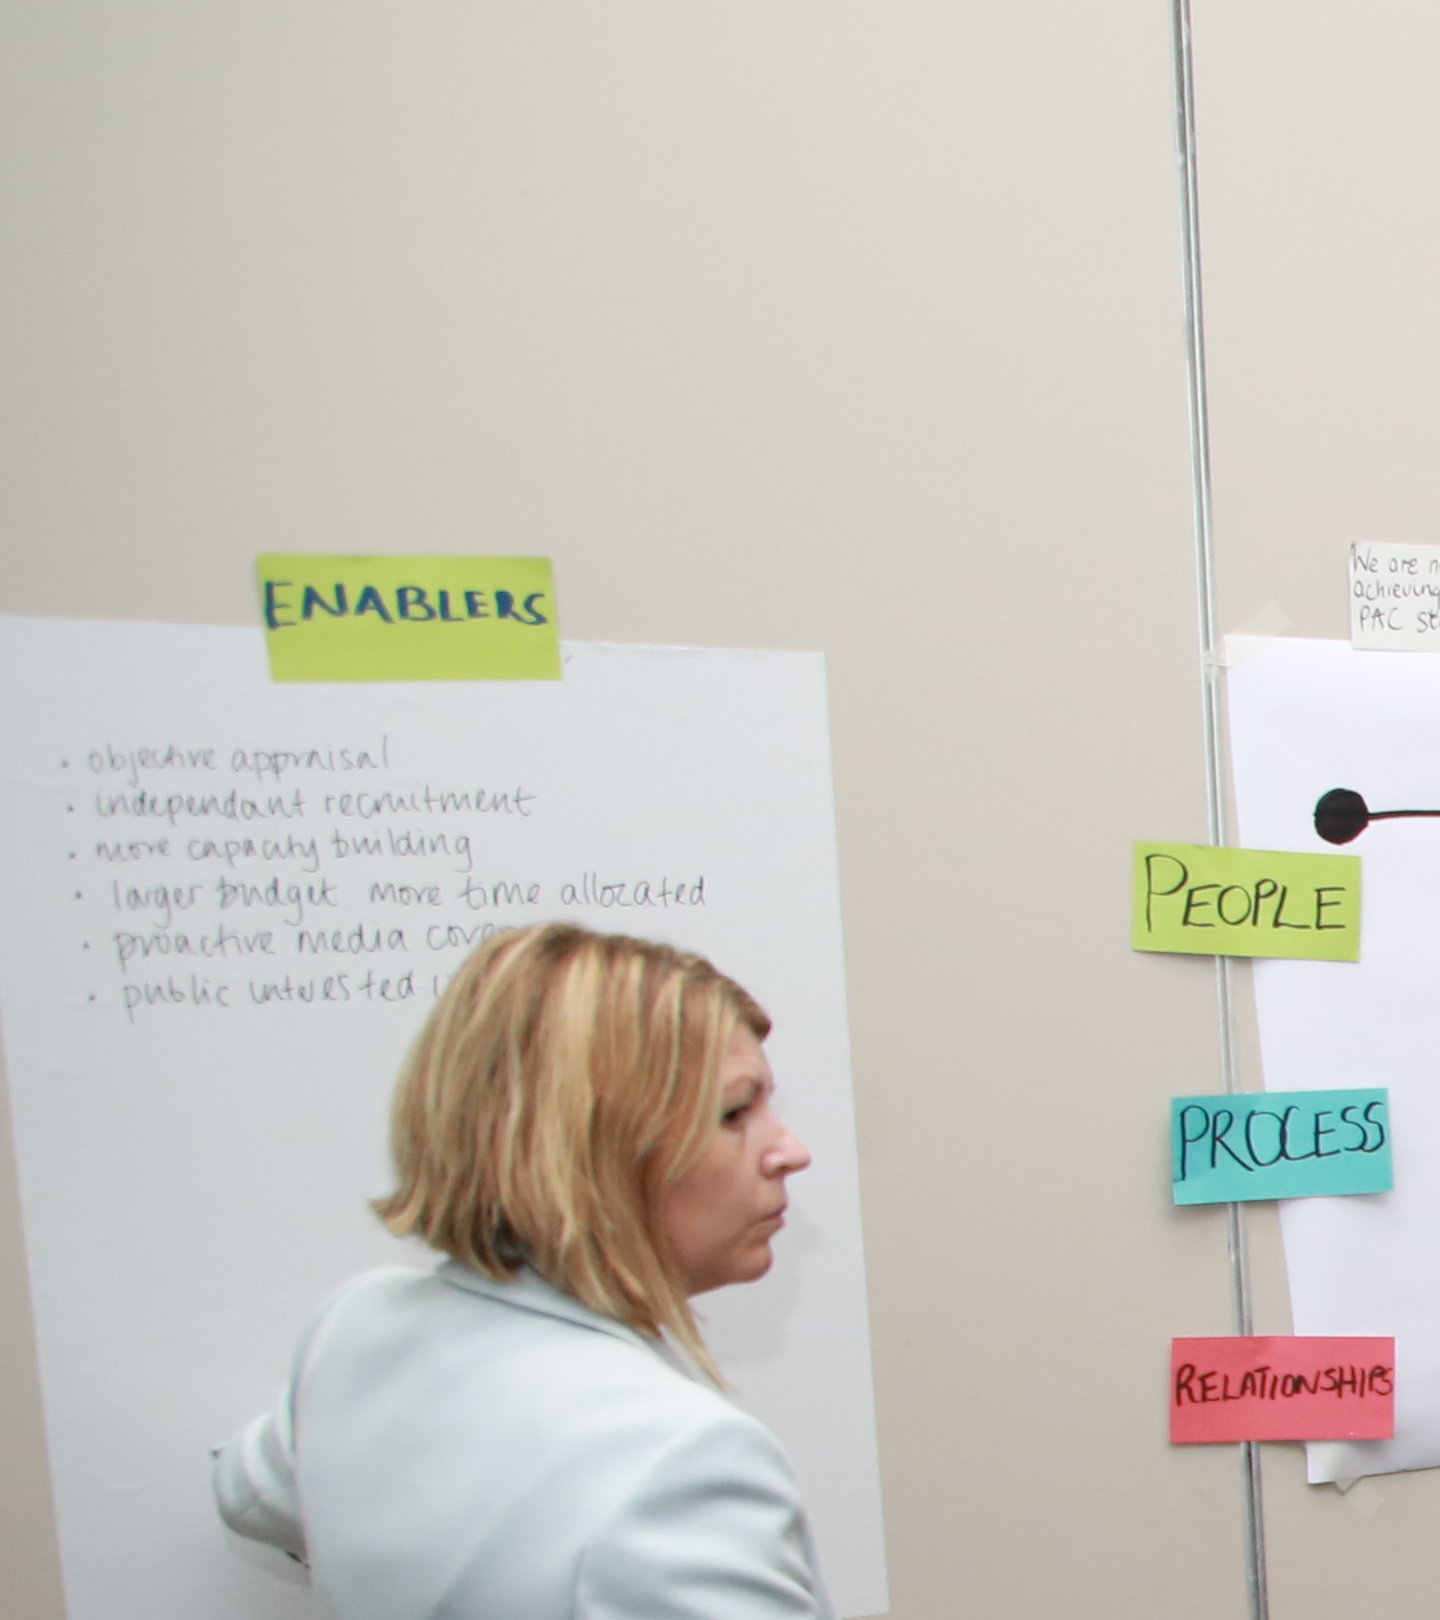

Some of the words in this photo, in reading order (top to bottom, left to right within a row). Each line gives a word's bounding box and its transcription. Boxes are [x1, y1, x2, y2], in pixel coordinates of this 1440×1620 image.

[1388, 557, 1419, 576] are
[263, 580, 549, 631] ENABLERS
[1359, 604, 1404, 632] PAC
[88, 743, 219, 788] objective
[231, 735, 389, 784] appraisal
[96, 838, 170, 863] more
[187, 833, 320, 873] capacity
[331, 828, 473, 873] building
[112, 878, 203, 928] larger
[217, 874, 339, 926] budget
[369, 878, 441, 907] more
[457, 874, 541, 911] time
[559, 870, 708, 909] allocated
[1144, 853, 1347, 933] PEOPLE
[112, 920, 277, 974] proactive
[298, 921, 409, 956] media
[121, 968, 231, 1024] public
[1180, 1100, 1386, 1182] PROCESS
[1175, 1362, 1394, 1407] RELATIONSHIPS
